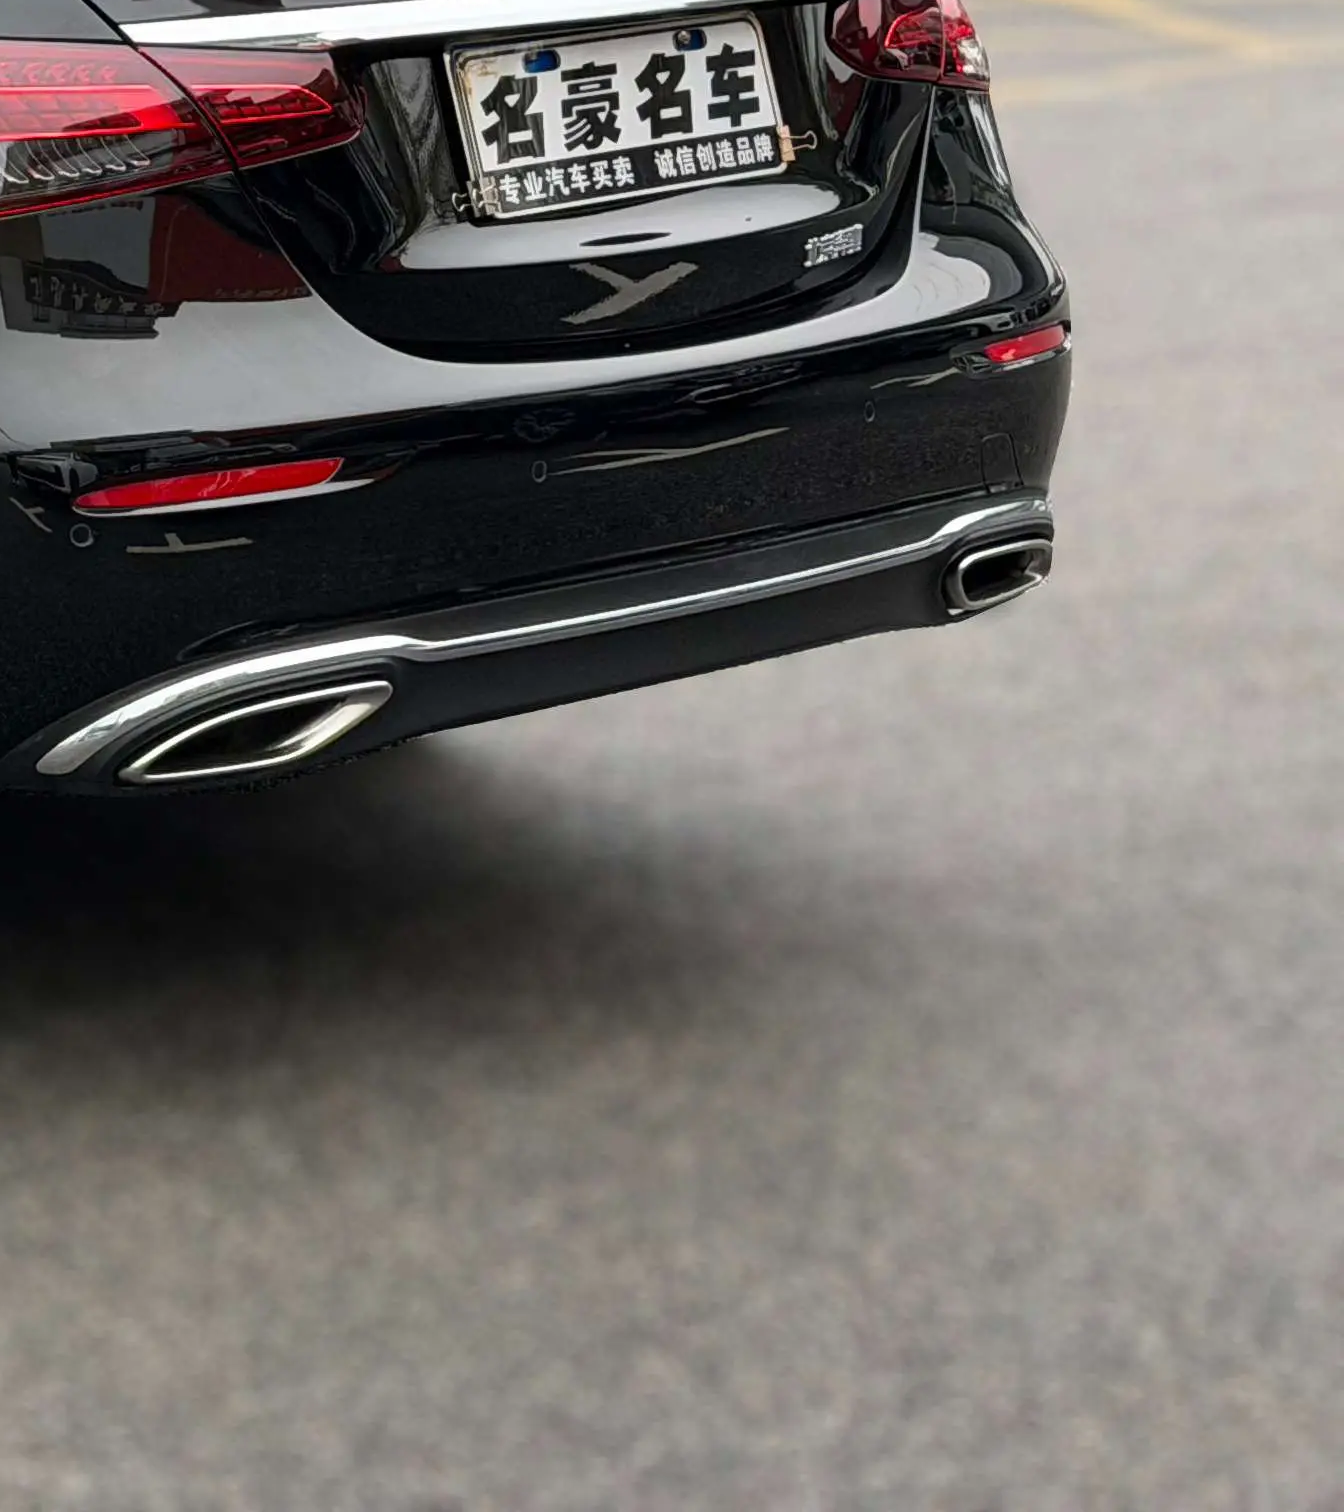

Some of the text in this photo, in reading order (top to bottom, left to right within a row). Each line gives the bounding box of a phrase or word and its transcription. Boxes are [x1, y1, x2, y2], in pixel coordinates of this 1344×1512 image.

[480, 43, 760, 164] 名豪名车
[499, 133, 775, 205] 专业汽车买卖 诚信创造品牌
